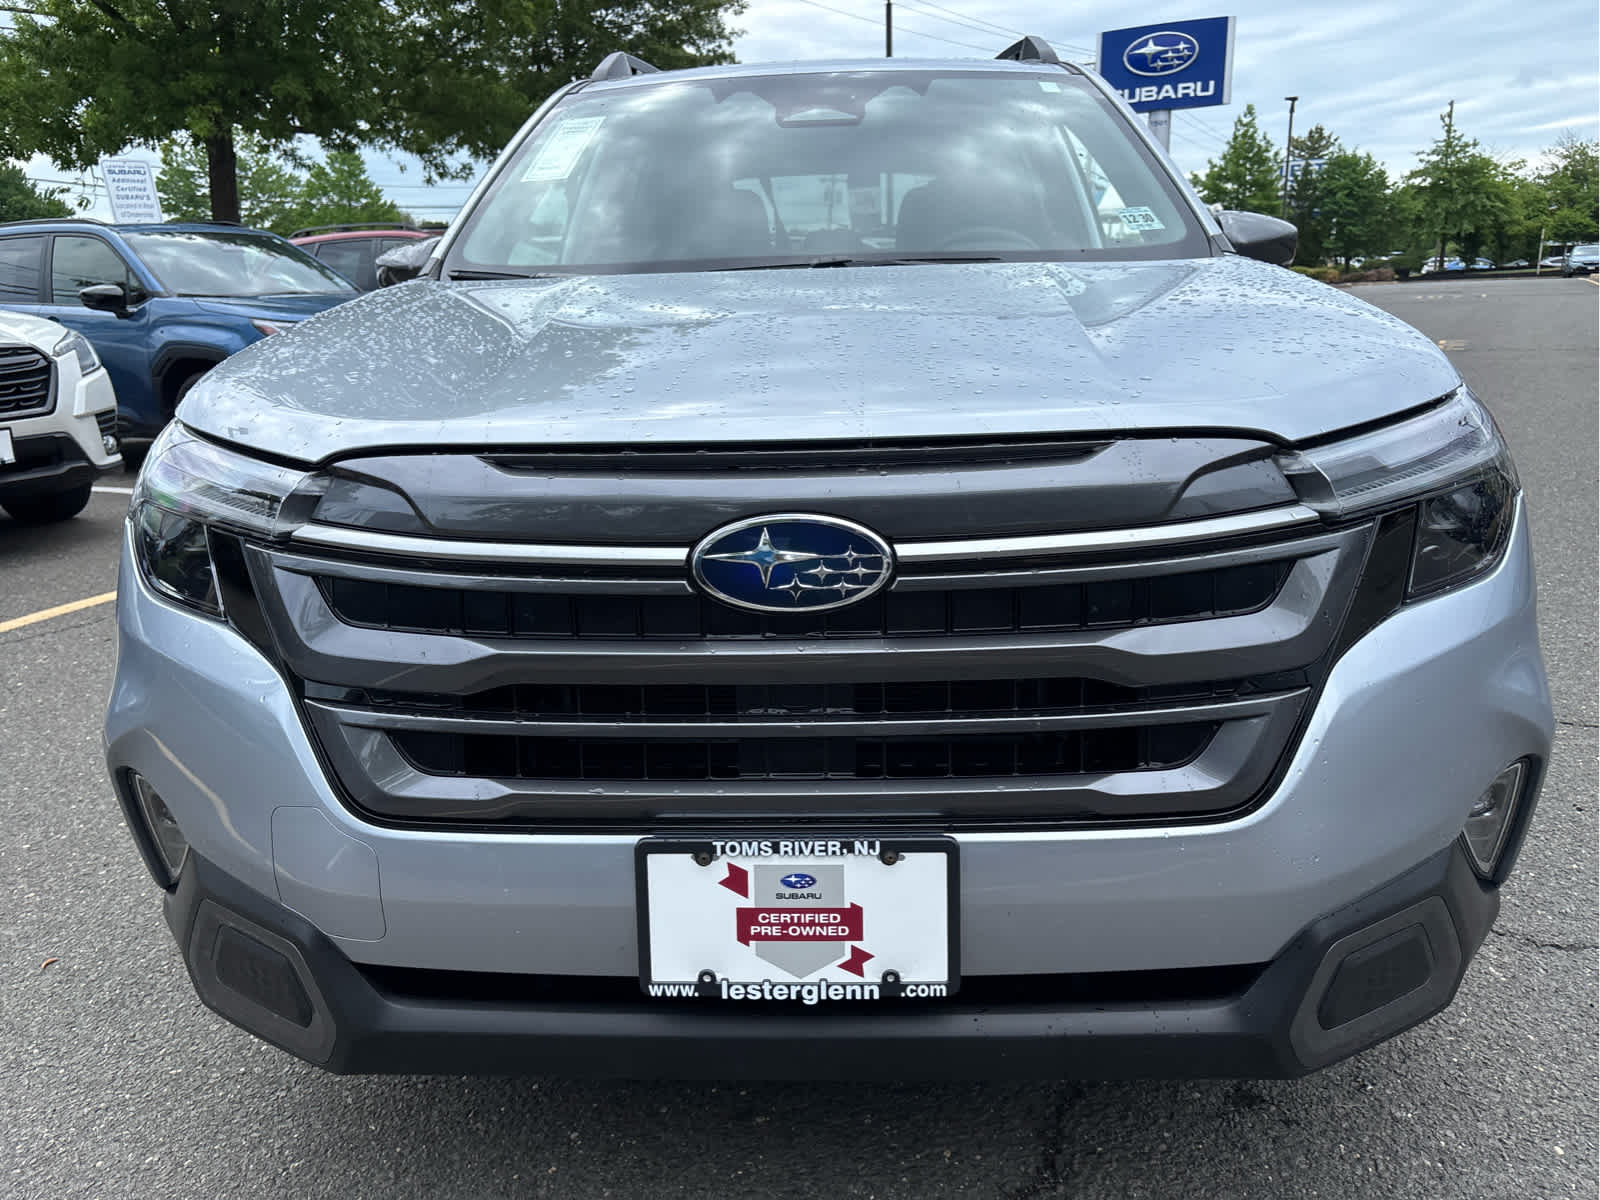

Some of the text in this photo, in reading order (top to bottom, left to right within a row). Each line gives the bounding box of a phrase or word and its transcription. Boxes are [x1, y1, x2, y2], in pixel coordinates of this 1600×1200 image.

[712, 840, 881, 857] TOMS RIVER, NJ
[775, 892, 822, 900] SUBARU
[758, 912, 841, 924] CERTIFIED
[750, 926, 849, 937] PRE-OWNED
[648, 980, 948, 1005] www. lesterglenn .com
